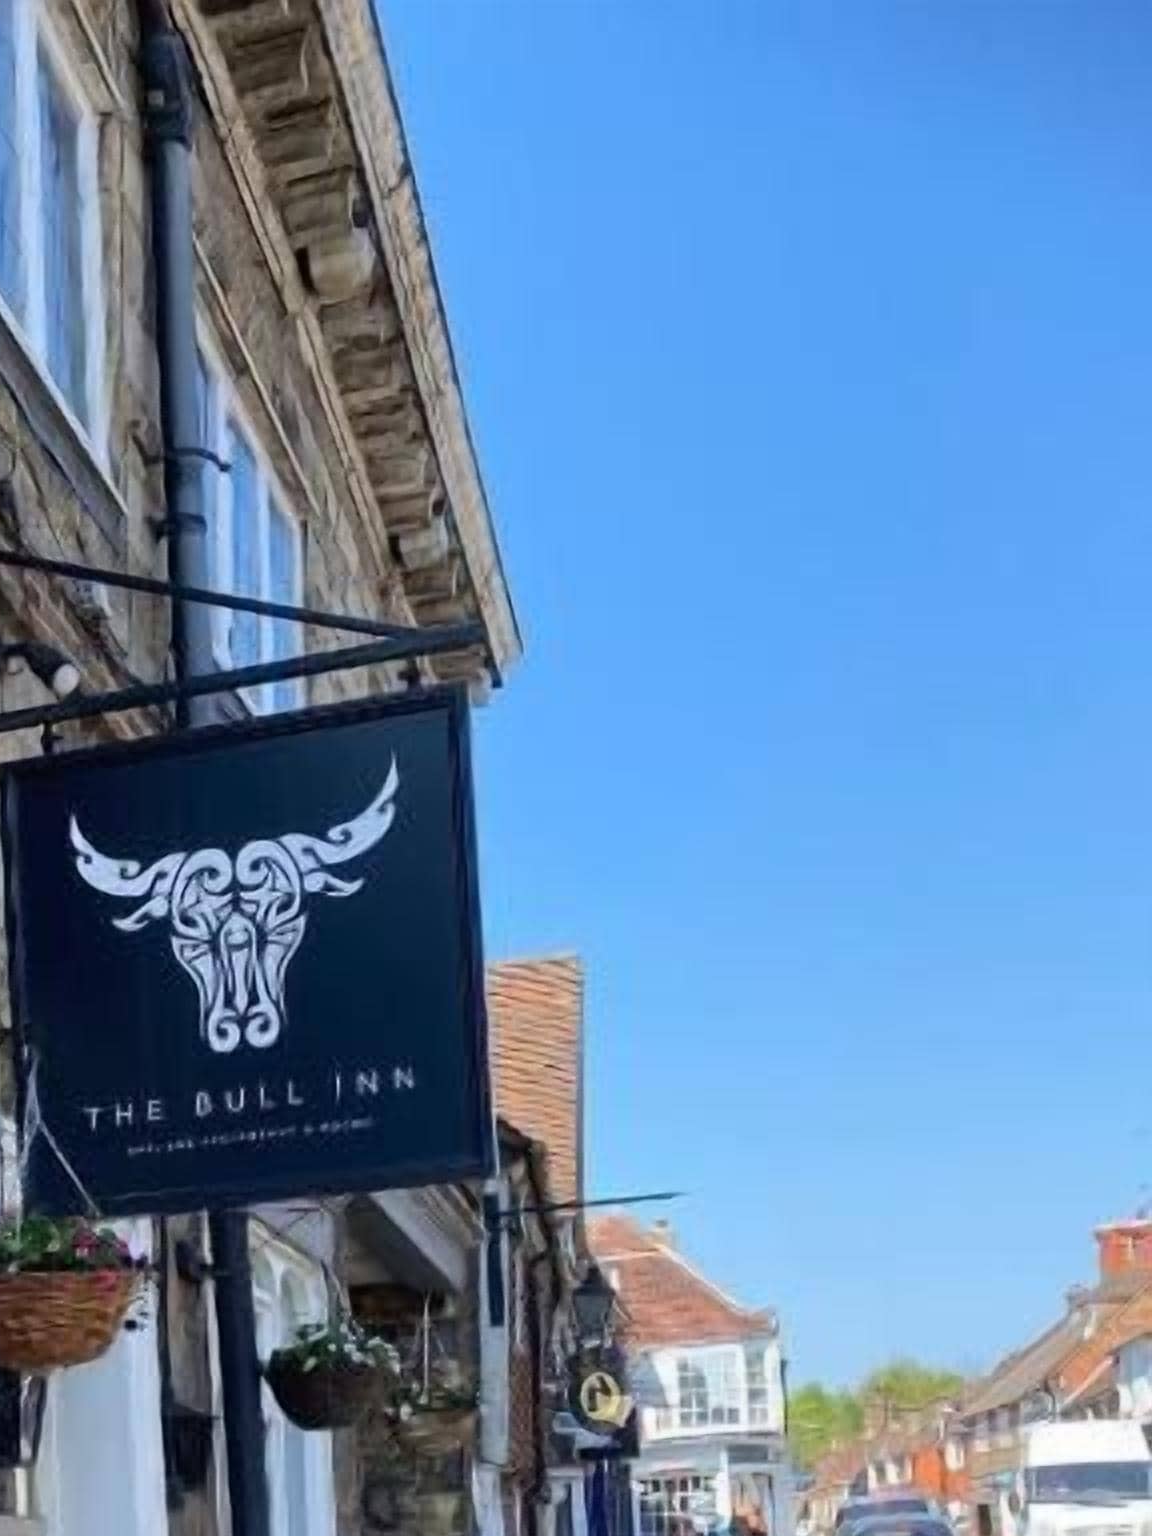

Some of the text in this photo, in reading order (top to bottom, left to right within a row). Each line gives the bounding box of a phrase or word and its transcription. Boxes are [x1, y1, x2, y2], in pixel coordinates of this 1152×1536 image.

[85, 1066, 414, 1131] THE BULL INN
